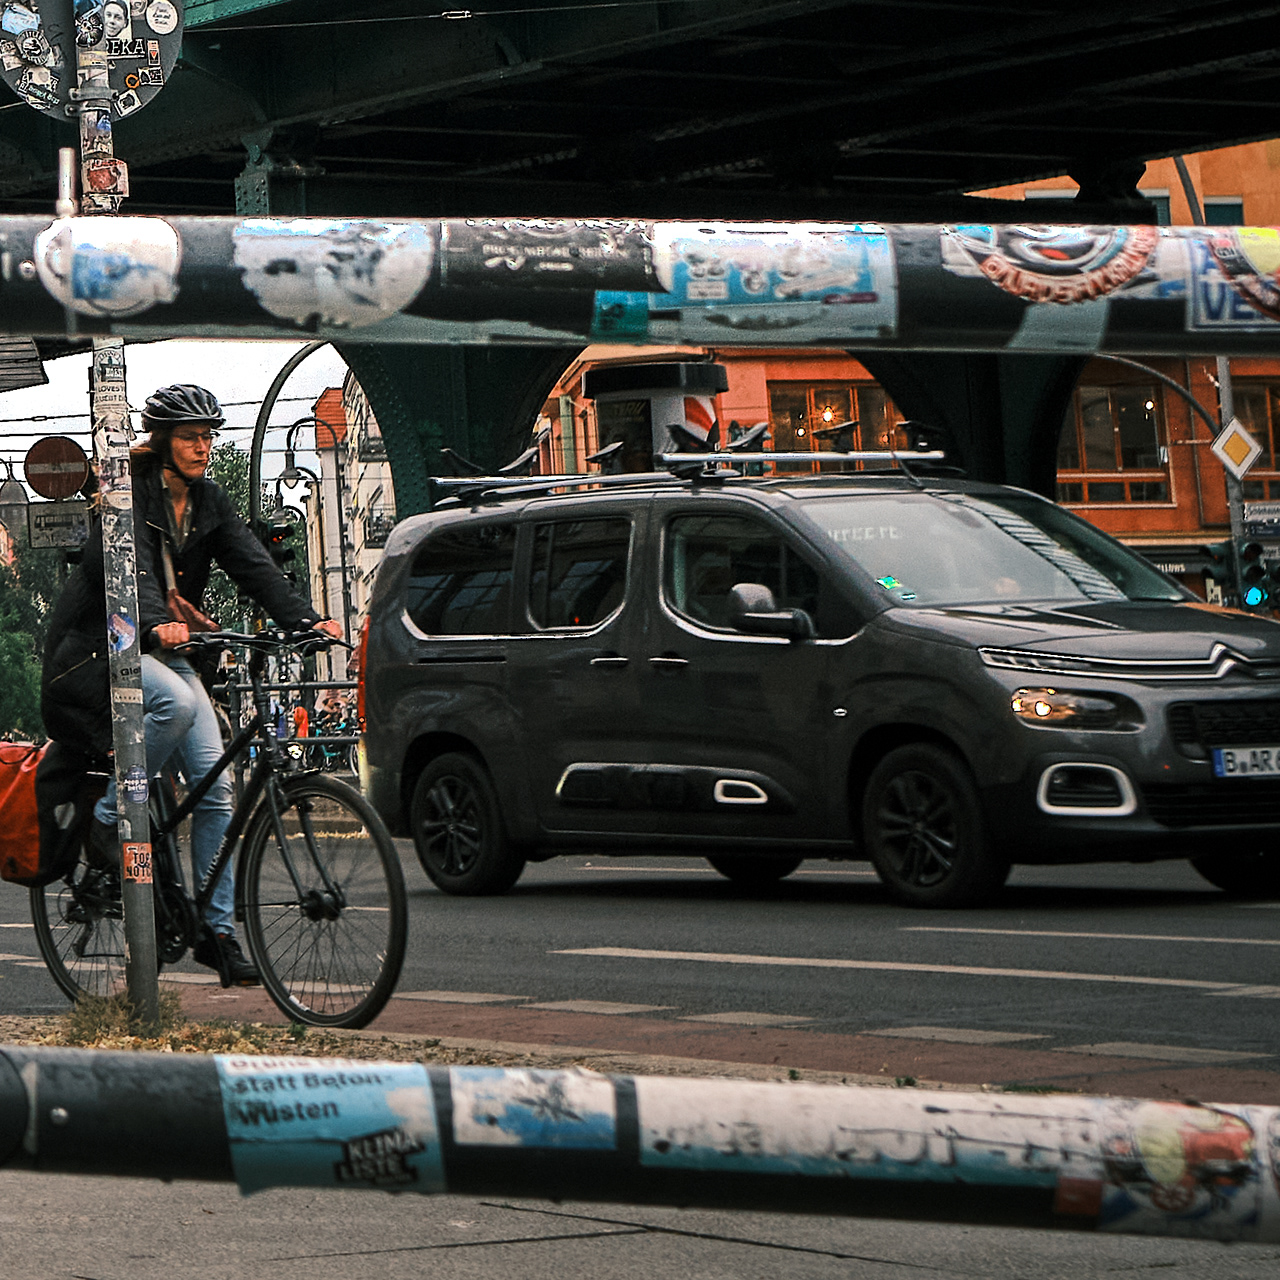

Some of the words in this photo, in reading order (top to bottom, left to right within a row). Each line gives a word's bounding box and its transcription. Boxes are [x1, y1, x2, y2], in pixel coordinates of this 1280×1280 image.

[120, 667, 140, 677] Glo
[1224, 751, 1238, 773] B
[347, 1129, 421, 1162] KLIMA
[338, 1158, 398, 1183] LISTE
